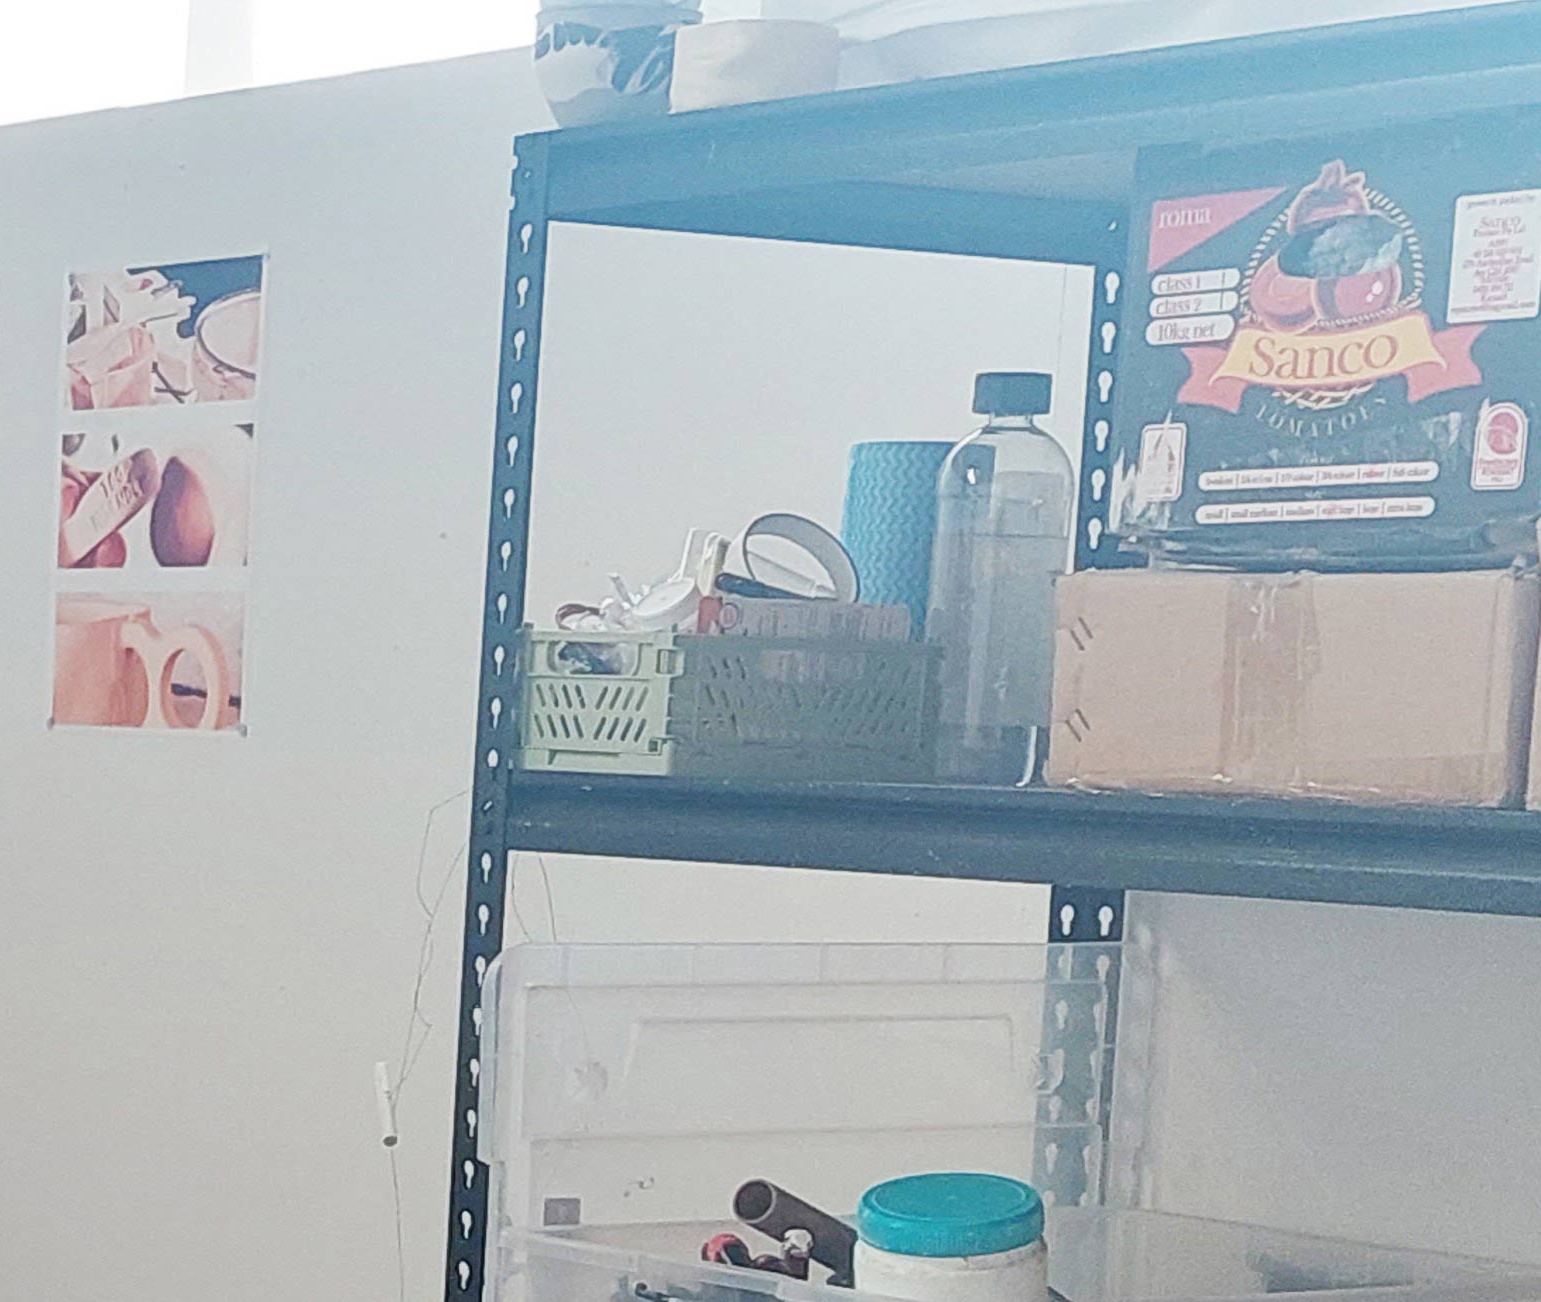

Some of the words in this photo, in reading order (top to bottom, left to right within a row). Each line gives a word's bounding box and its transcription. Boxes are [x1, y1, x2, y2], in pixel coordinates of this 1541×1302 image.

[1158, 206, 1212, 229] roma
[1157, 276, 1192, 293] class
[1156, 299, 1190, 315] class
[1193, 298, 1203, 312] 2
[1193, 323, 1216, 338] net
[1248, 334, 1399, 379] Sanco
